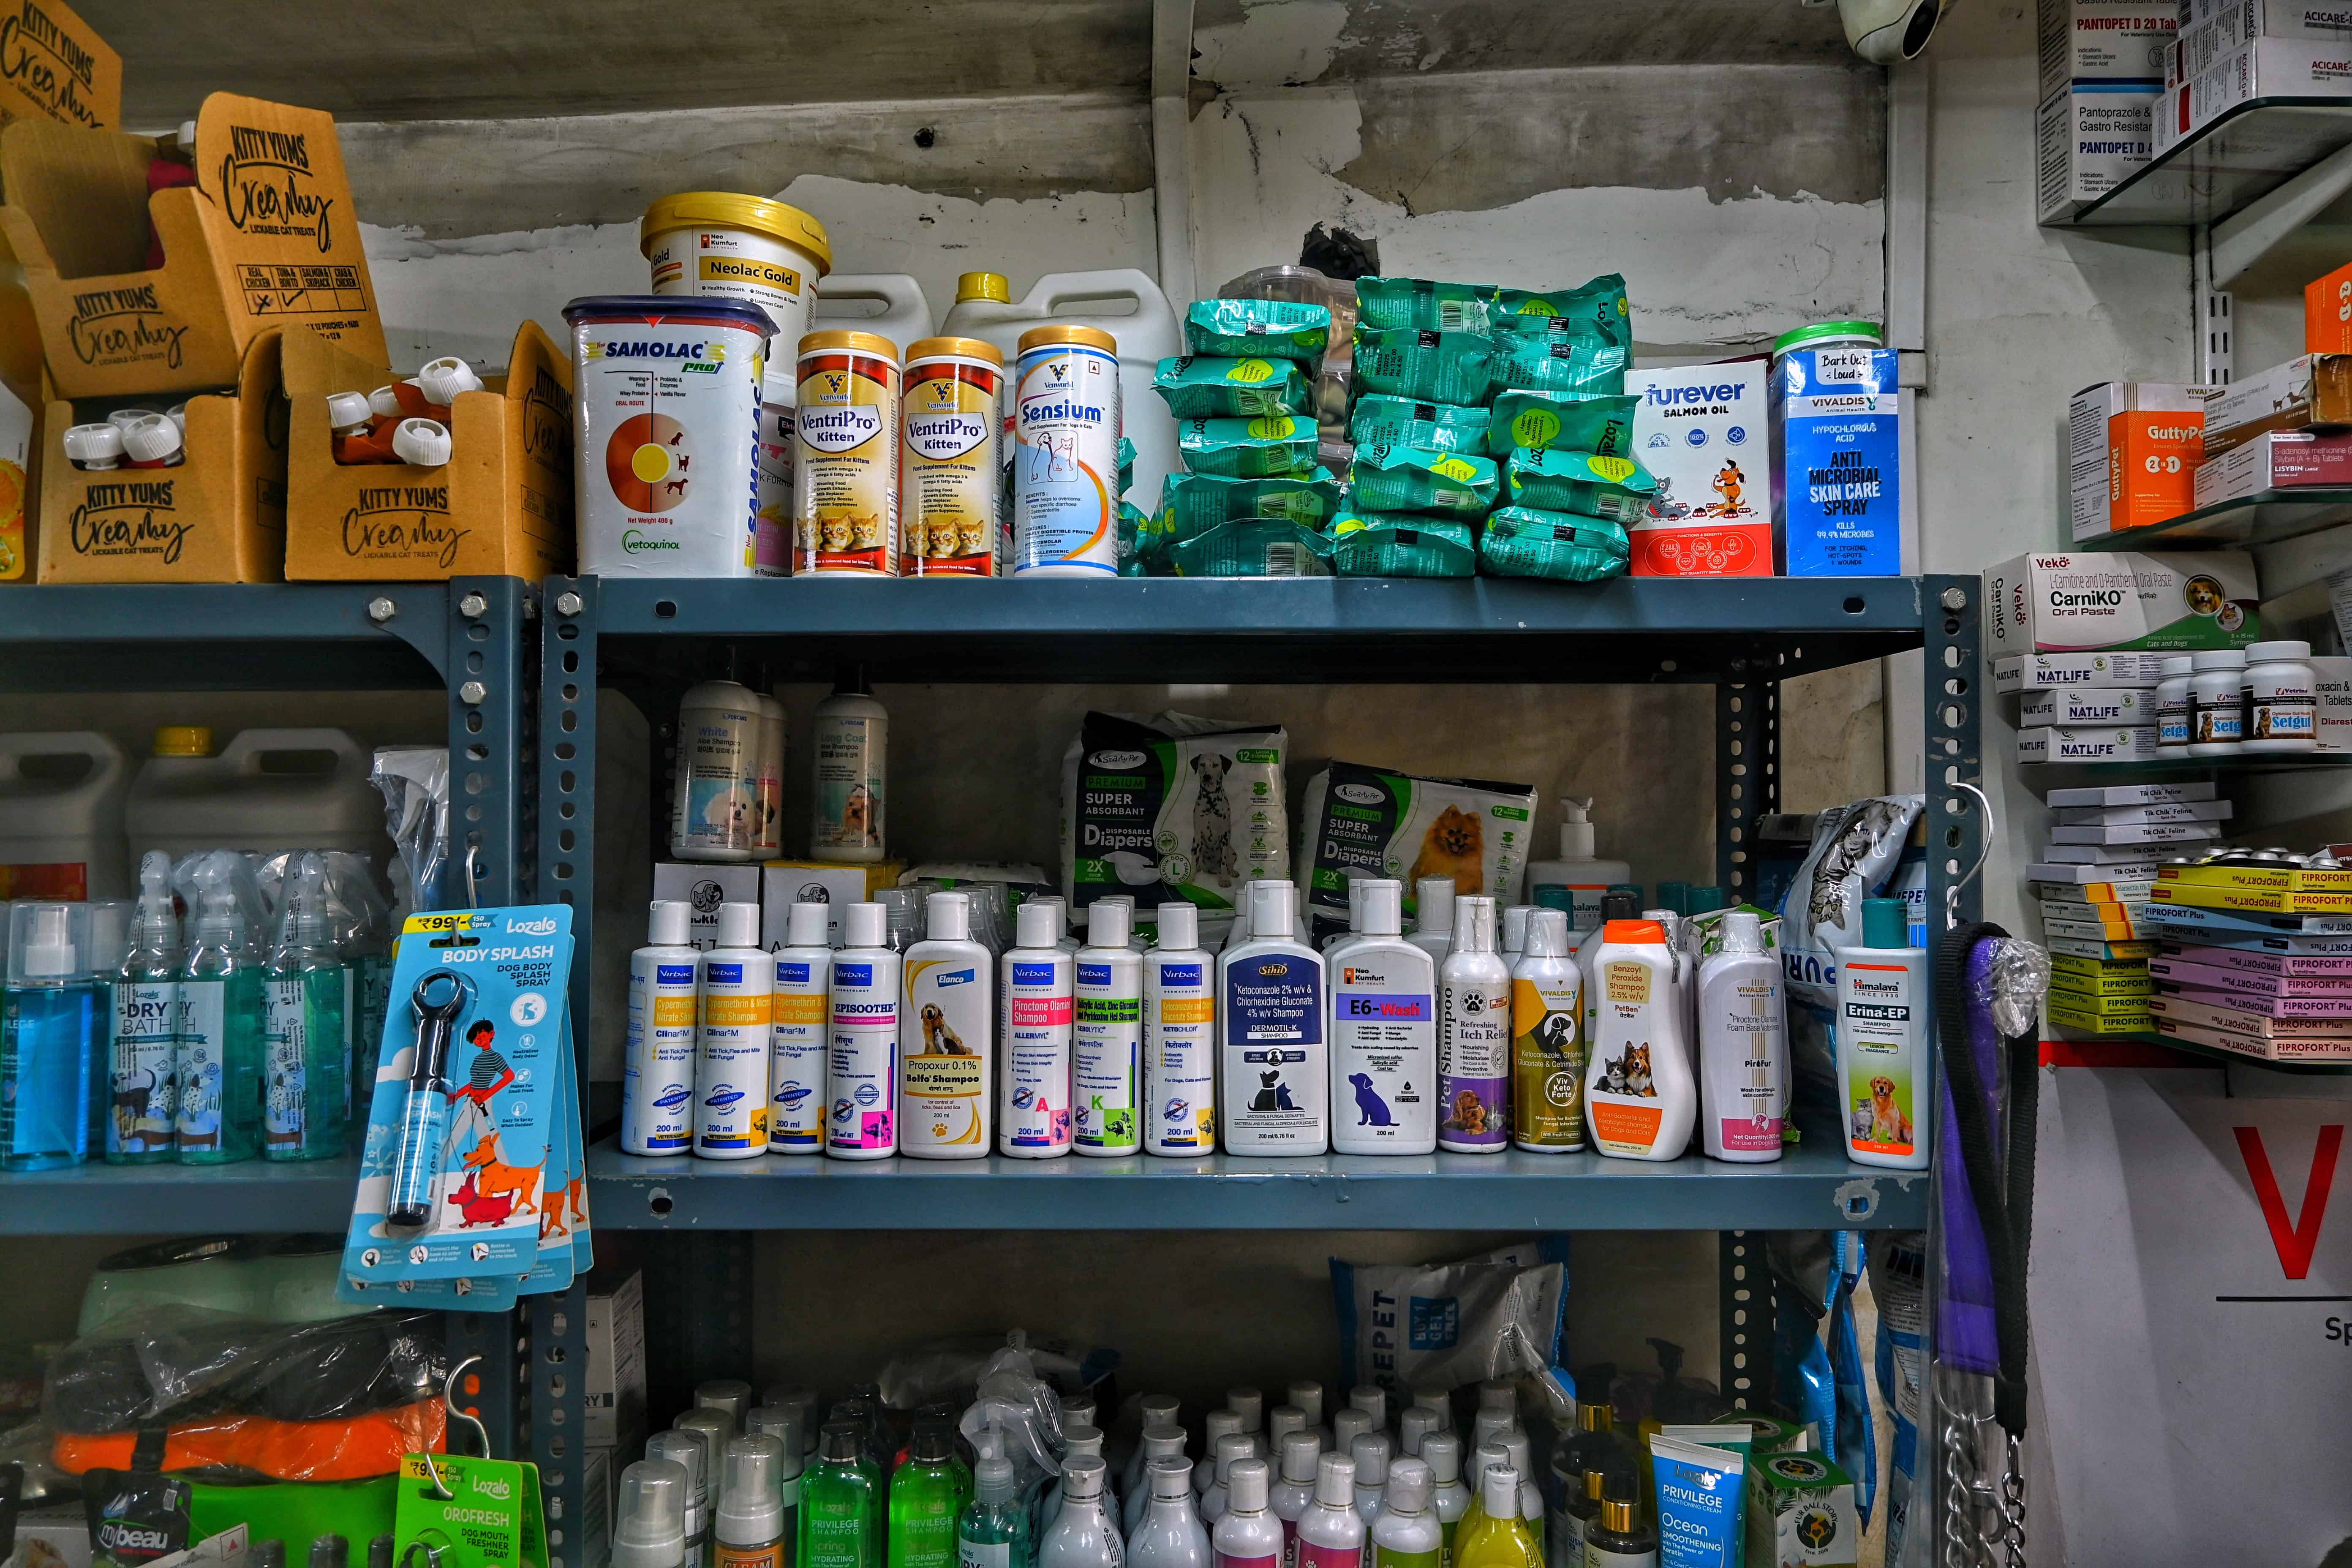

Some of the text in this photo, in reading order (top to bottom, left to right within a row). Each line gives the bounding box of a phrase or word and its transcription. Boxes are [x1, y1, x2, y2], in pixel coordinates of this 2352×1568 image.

[2077, 17, 2177, 30] PANTOPET D 20 Tab
[2079, 107, 2141, 120] Pantoprazole
[2079, 121, 2110, 132] Gastro
[231, 125, 309, 169] KITTY YUMS
[223, 154, 333, 253] Creamy
[250, 224, 316, 237] LICKABLE CAT TREATS
[710, 262, 792, 286] Neolac Gold
[246, 278, 270, 287] CHICKEN
[306, 278, 330, 287] SKIPJACK
[335, 279, 356, 287] CHICKEN
[754, 298, 773, 307] Lustrous
[605, 343, 704, 358] SAMOLAC
[1821, 354, 1847, 367] Bark
[1834, 370, 1855, 380] Loud
[1647, 383, 1745, 405] furever
[1812, 397, 1865, 407] VIVALDIS
[1022, 399, 1102, 423] Sensium
[1664, 406, 1729, 417] SALMON OIL
[802, 411, 872, 430] VentriPro
[1813, 425, 1876, 434] HYPOCHLOROUS
[817, 433, 854, 442] Kitten
[1835, 434, 1854, 442] ACID
[1830, 451, 1861, 467] ANTI
[1809, 467, 1881, 485] MICROBIAL
[87, 482, 173, 508] KITTY YUMS
[1810, 482, 1881, 502] SKIN CARE
[360, 488, 447, 510] KITTY YUMS
[1824, 500, 1867, 516] SPRAY
[1840, 531, 1874, 539] MICROBES
[2051, 591, 2121, 606] CarniKO
[2137, 592, 2157, 600] कार्निको
[2053, 608, 2115, 616] Oral Paste
[1996, 670, 2020, 681] NATLIFE
[2036, 671, 2091, 681] NATLIFE
[2324, 695, 2352, 705] Tablets
[2069, 707, 2119, 717] NATLIFE
[2272, 716, 2311, 729] Setgut
[698, 726, 728, 737] White
[1088, 778, 1143, 787] PREMIUM
[1086, 793, 1132, 804] SUPER
[1085, 825, 1152, 849] Diapers
[1087, 861, 1103, 872] 2X
[2302, 874, 2350, 882] FIPROFORT
[2145, 908, 2204, 919] FIPROFORT Plus
[507, 917, 556, 935] Lozalo
[442, 945, 554, 963] BODY SPLASH
[497, 963, 552, 972] DOG BODY
[1614, 965, 1641, 974] Benzoyl
[516, 979, 550, 987] SPRAY
[939, 975, 964, 983] Elanco
[1237, 985, 1304, 995] Ketoconazole 2% w/v
[1610, 983, 1645, 992] Shampoo
[1854, 979, 1898, 991] Himalaya
[708, 1000, 749, 1009] Cypermethrin
[1015, 1000, 1070, 1010] Piroctone Olamine
[1237, 997, 1312, 1005] Chlorhexidine Gluconate
[128, 1002, 166, 1018] DRY
[835, 1003, 893, 1013] EPISOOTHE
[1351, 1000, 1420, 1015] E6-Wash
[1849, 1005, 1906, 1018] Erina-EP
[730, 1013, 757, 1022] Shampoo
[1015, 1013, 1047, 1024] Shampoo
[1273, 1009, 1303, 1018] Shampoo
[122, 1018, 172, 1033] BATH
[1441, 988, 1456, 1073] Shampoo
[1460, 1021, 1497, 1029] Refreshing
[1460, 1030, 1484, 1039] Itch
[2277, 1043, 2351, 1052] FIPROFORT Plus
[909, 1061, 976, 1071] Propoxur 0.1%
[906, 1075, 979, 1083] Bolfo Shampoo
[710, 1094, 738, 1104] PATENTED
[1441, 1078, 1451, 1109] Pet
[2232, 1125, 2344, 1279] V
[1663, 1484, 1722, 1508] PRIVILEGE
[443, 1506, 509, 1526] OROFRESH
[811, 1520, 859, 1529] PRIVILEGE
[1662, 1512, 1707, 1536] Ocean
[99, 1524, 167, 1548] mybeau
[462, 1528, 509, 1541] DOG MOUTH
[467, 1538, 509, 1550] FRESHNER
[1662, 1530, 1721, 1551] SMOOTHENING
